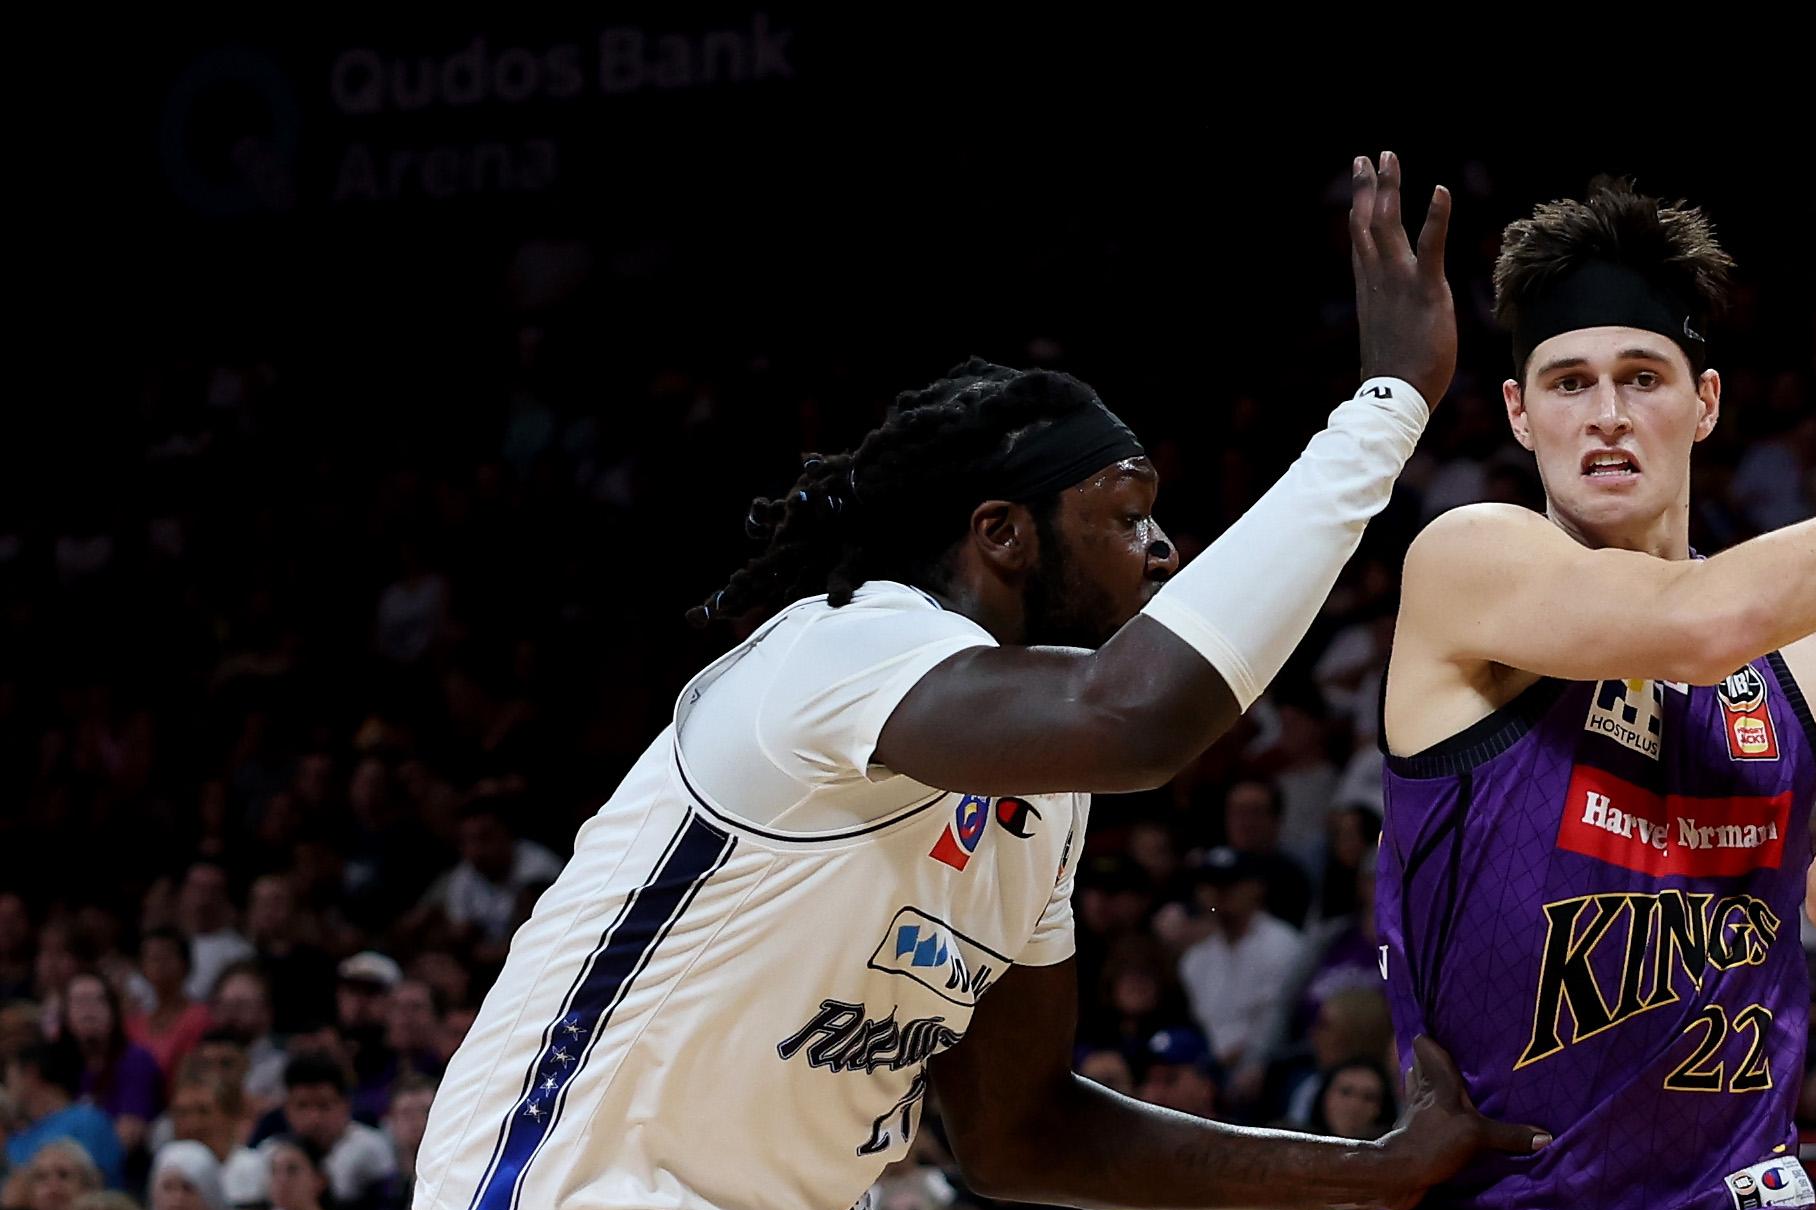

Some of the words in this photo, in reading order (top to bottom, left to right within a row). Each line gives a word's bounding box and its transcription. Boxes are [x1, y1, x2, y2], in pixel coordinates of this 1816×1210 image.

[597, 9, 798, 95] Bank
[331, 134, 560, 202] Arena
[1590, 714, 1658, 756] HOSTPLUS
[1581, 790, 1671, 857] Harve
[1512, 889, 1782, 1071] KINGS
[1663, 1003, 1774, 1093] 22
